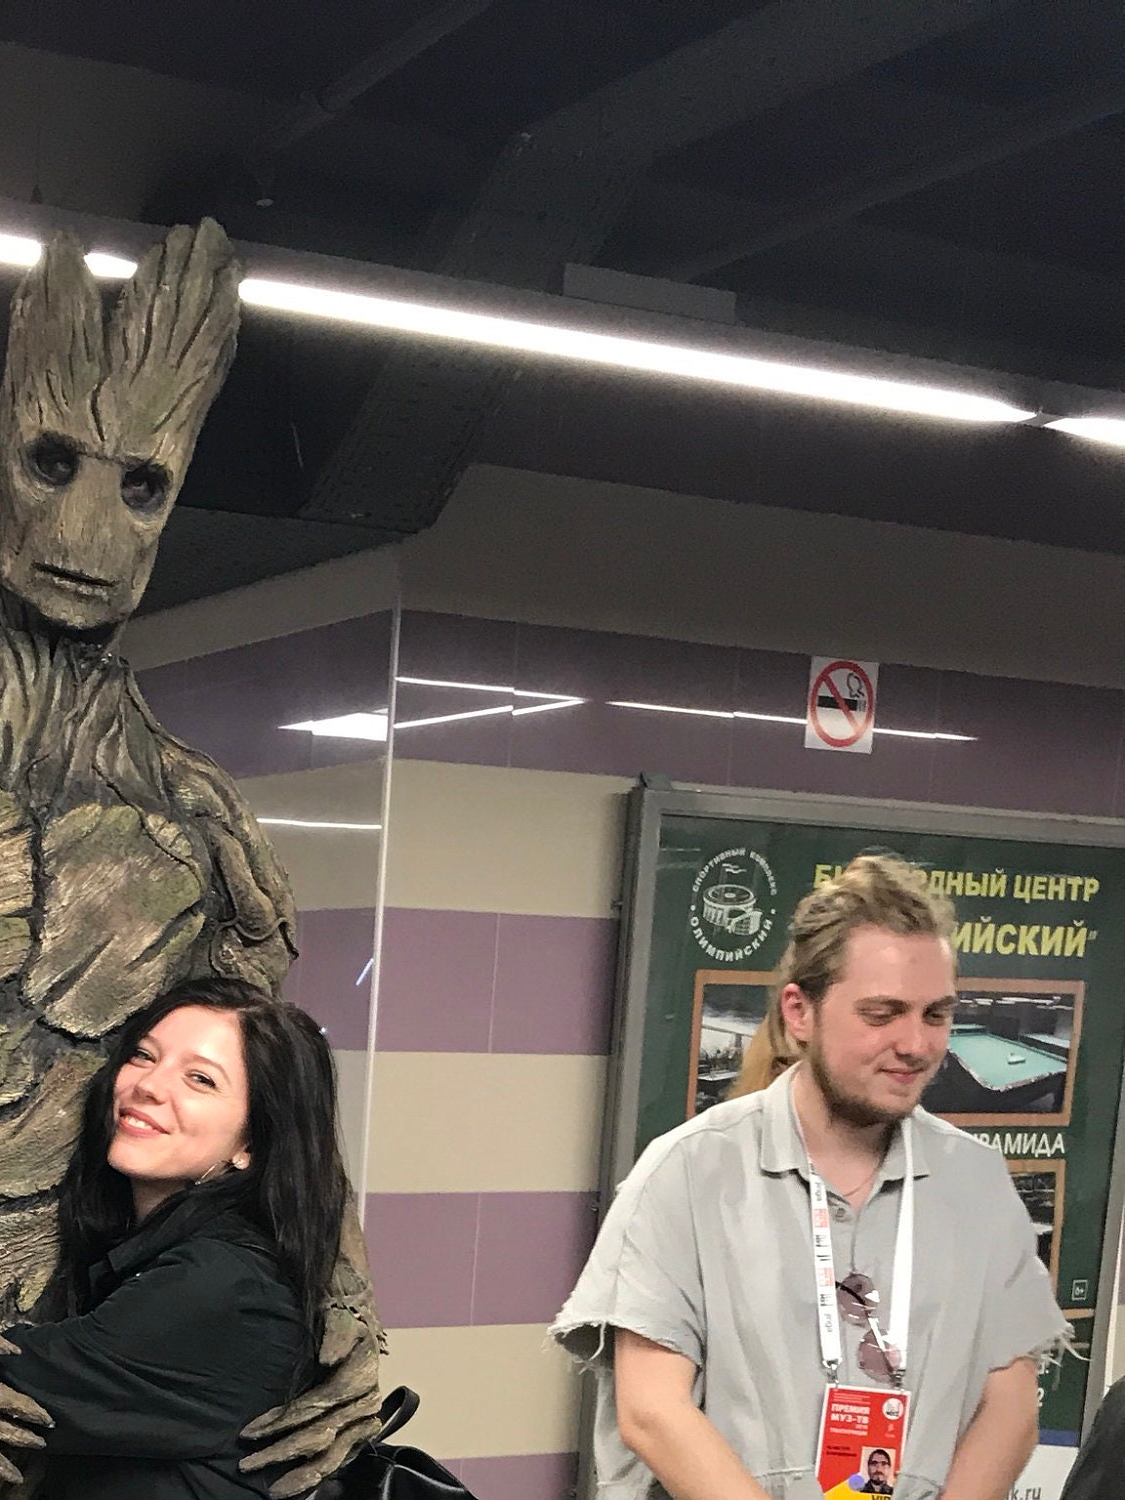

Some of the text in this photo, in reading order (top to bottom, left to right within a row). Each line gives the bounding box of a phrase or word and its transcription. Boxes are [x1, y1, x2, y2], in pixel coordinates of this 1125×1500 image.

[813, 864, 1100, 902] БРДНЫЙ ЦЕНТР
[690, 916, 773, 962] ОЛИМПИЙСКИЙ
[974, 1132, 1065, 1158] РАМИДА
[830, 1413, 870, 1424] МУЗ-ТВ
